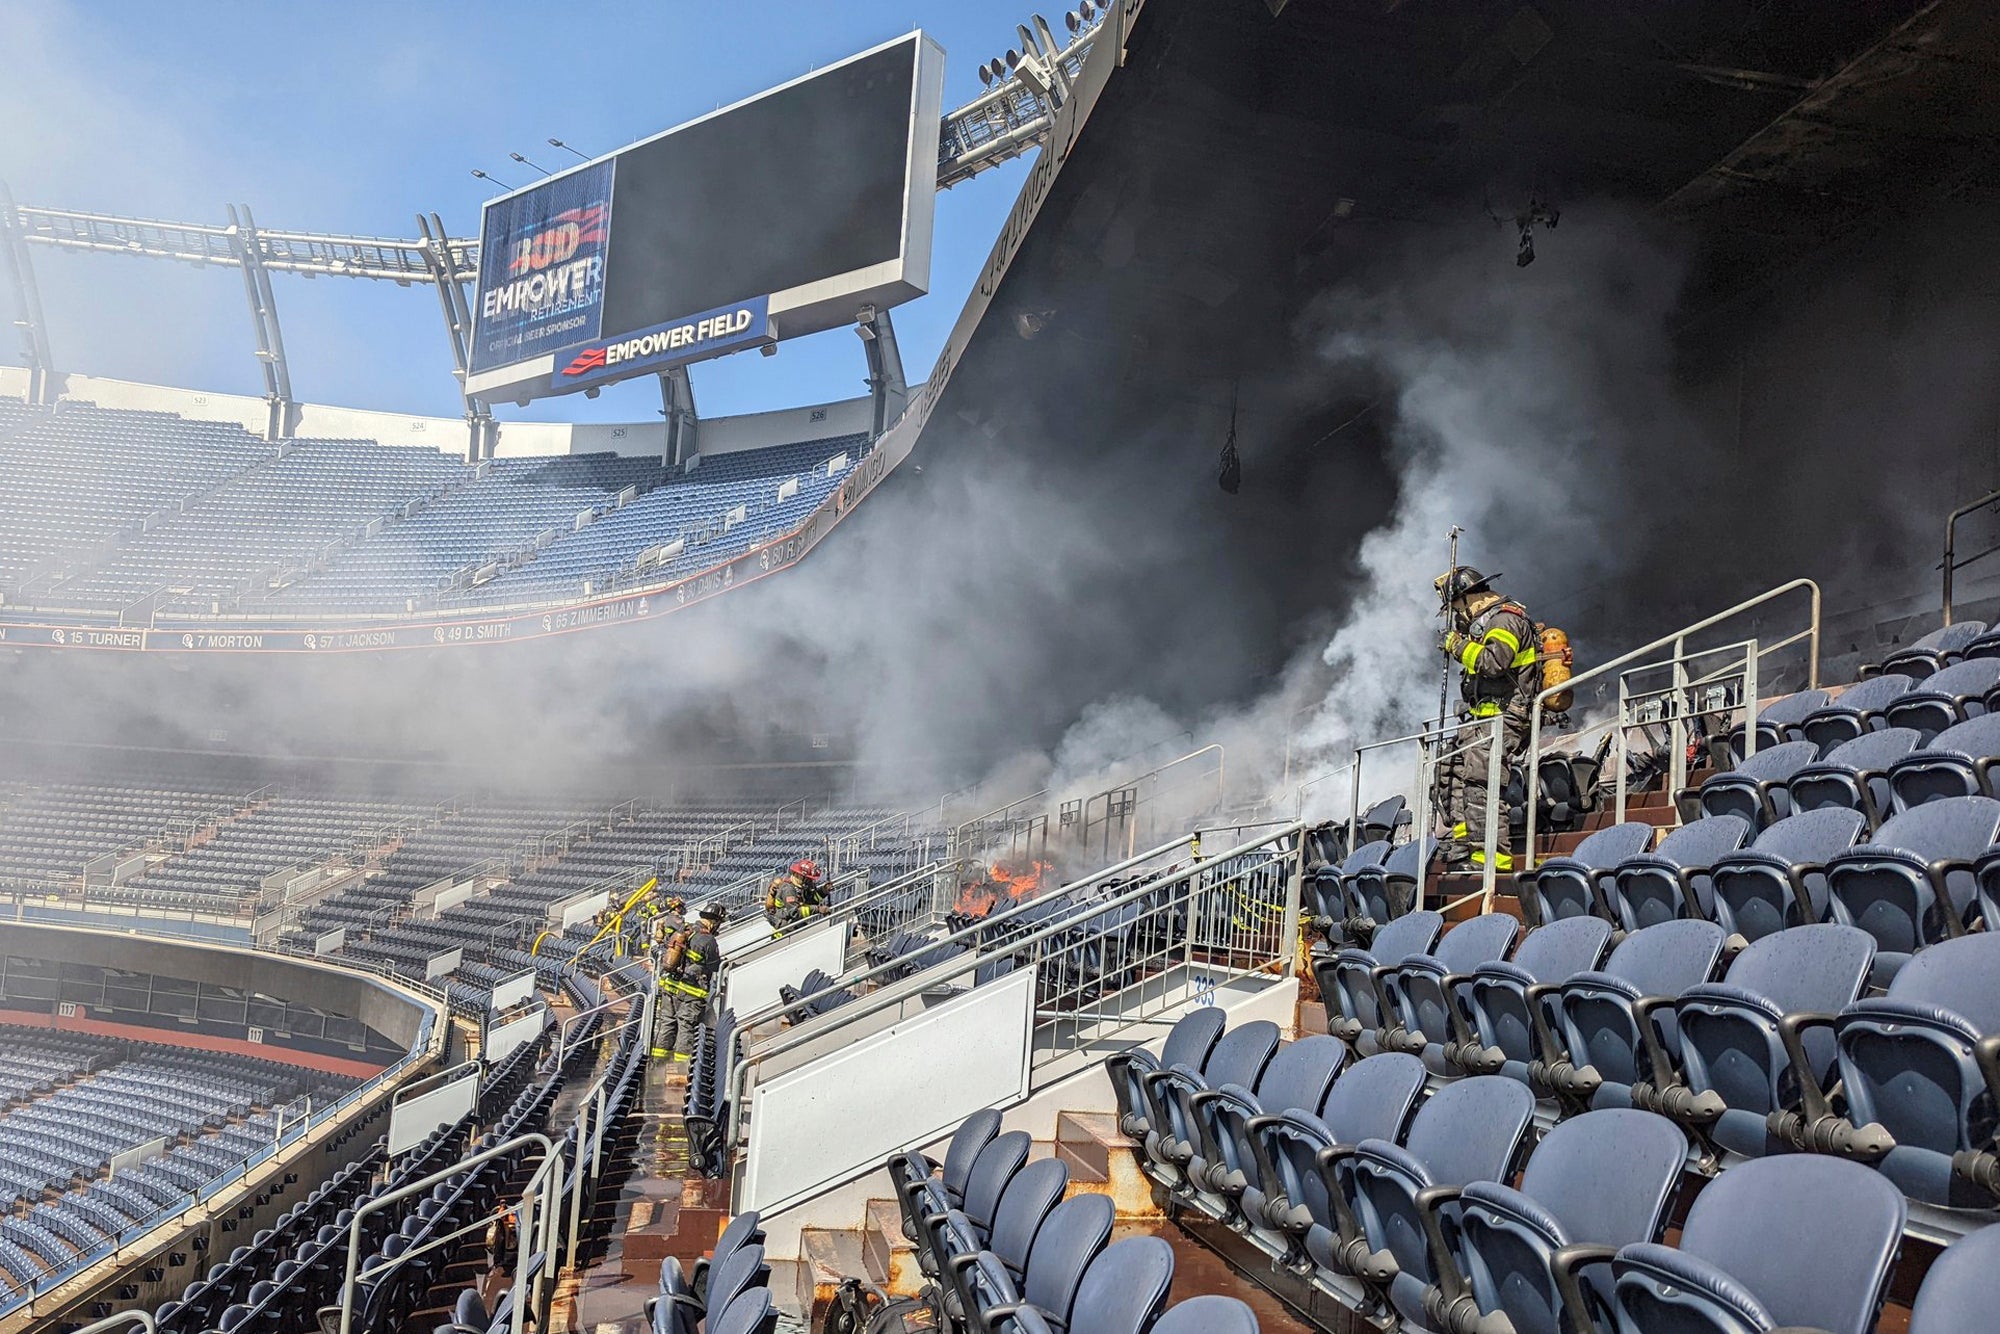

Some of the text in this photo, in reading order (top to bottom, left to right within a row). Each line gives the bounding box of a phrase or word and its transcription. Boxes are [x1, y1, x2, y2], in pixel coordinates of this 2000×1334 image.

[483, 255, 603, 318] EMPOWER
[531, 289, 601, 322] RETIREMENT
[606, 309, 752, 365] EMPOWER FIELD
[811, 410, 825, 421] 526
[613, 428, 626, 438] 525
[556, 601, 635, 629] 65 ZIMMERMAN
[70, 631, 83, 644] 15
[88, 632, 141, 647] TURNER
[448, 627, 462, 640] 49
[477, 623, 511, 639] SMITH
[197, 635, 263, 648] 7 MORTON
[319, 636, 333, 648] 57
[346, 632, 395, 647] JACKSON
[1194, 975, 1215, 1007] 333
[61, 1004, 75, 1016] 117
[250, 1029, 263, 1042] 117
